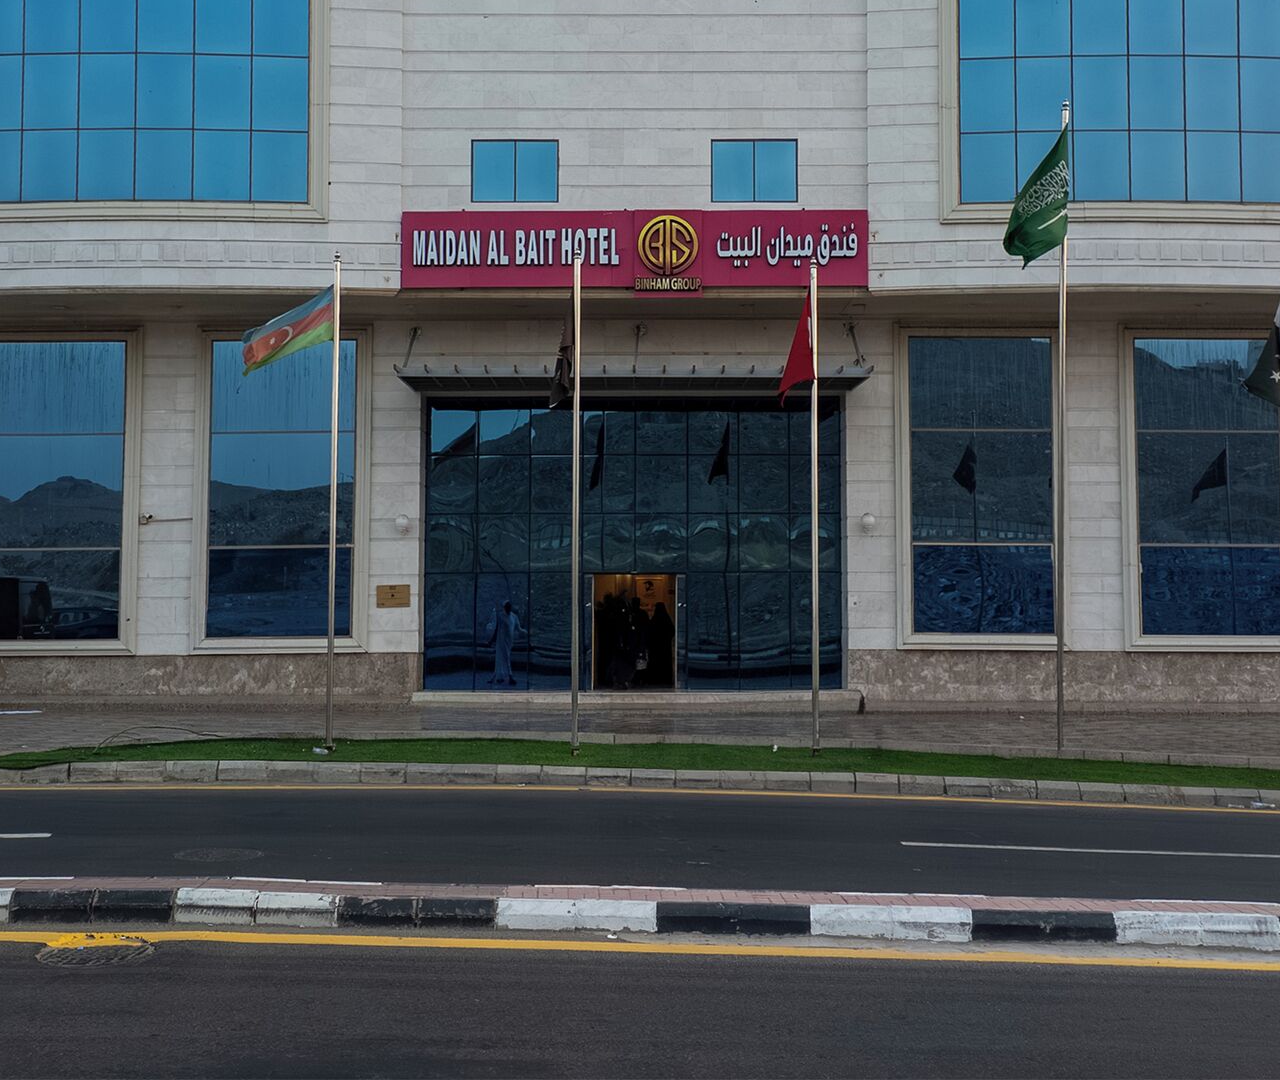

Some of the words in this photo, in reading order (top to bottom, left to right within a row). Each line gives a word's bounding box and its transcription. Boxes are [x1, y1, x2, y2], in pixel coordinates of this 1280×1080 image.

[413, 230, 481, 265] MAIDAN
[487, 230, 510, 265] AL
[515, 230, 556, 265] BAIT
[561, 228, 620, 265] HOTEL
[716, 225, 762, 267] البيت
[766, 225, 814, 267] ميدان
[817, 222, 858, 266] فندق
[635, 278, 670, 290] BINHAM
[671, 278, 701, 290] GROUP
